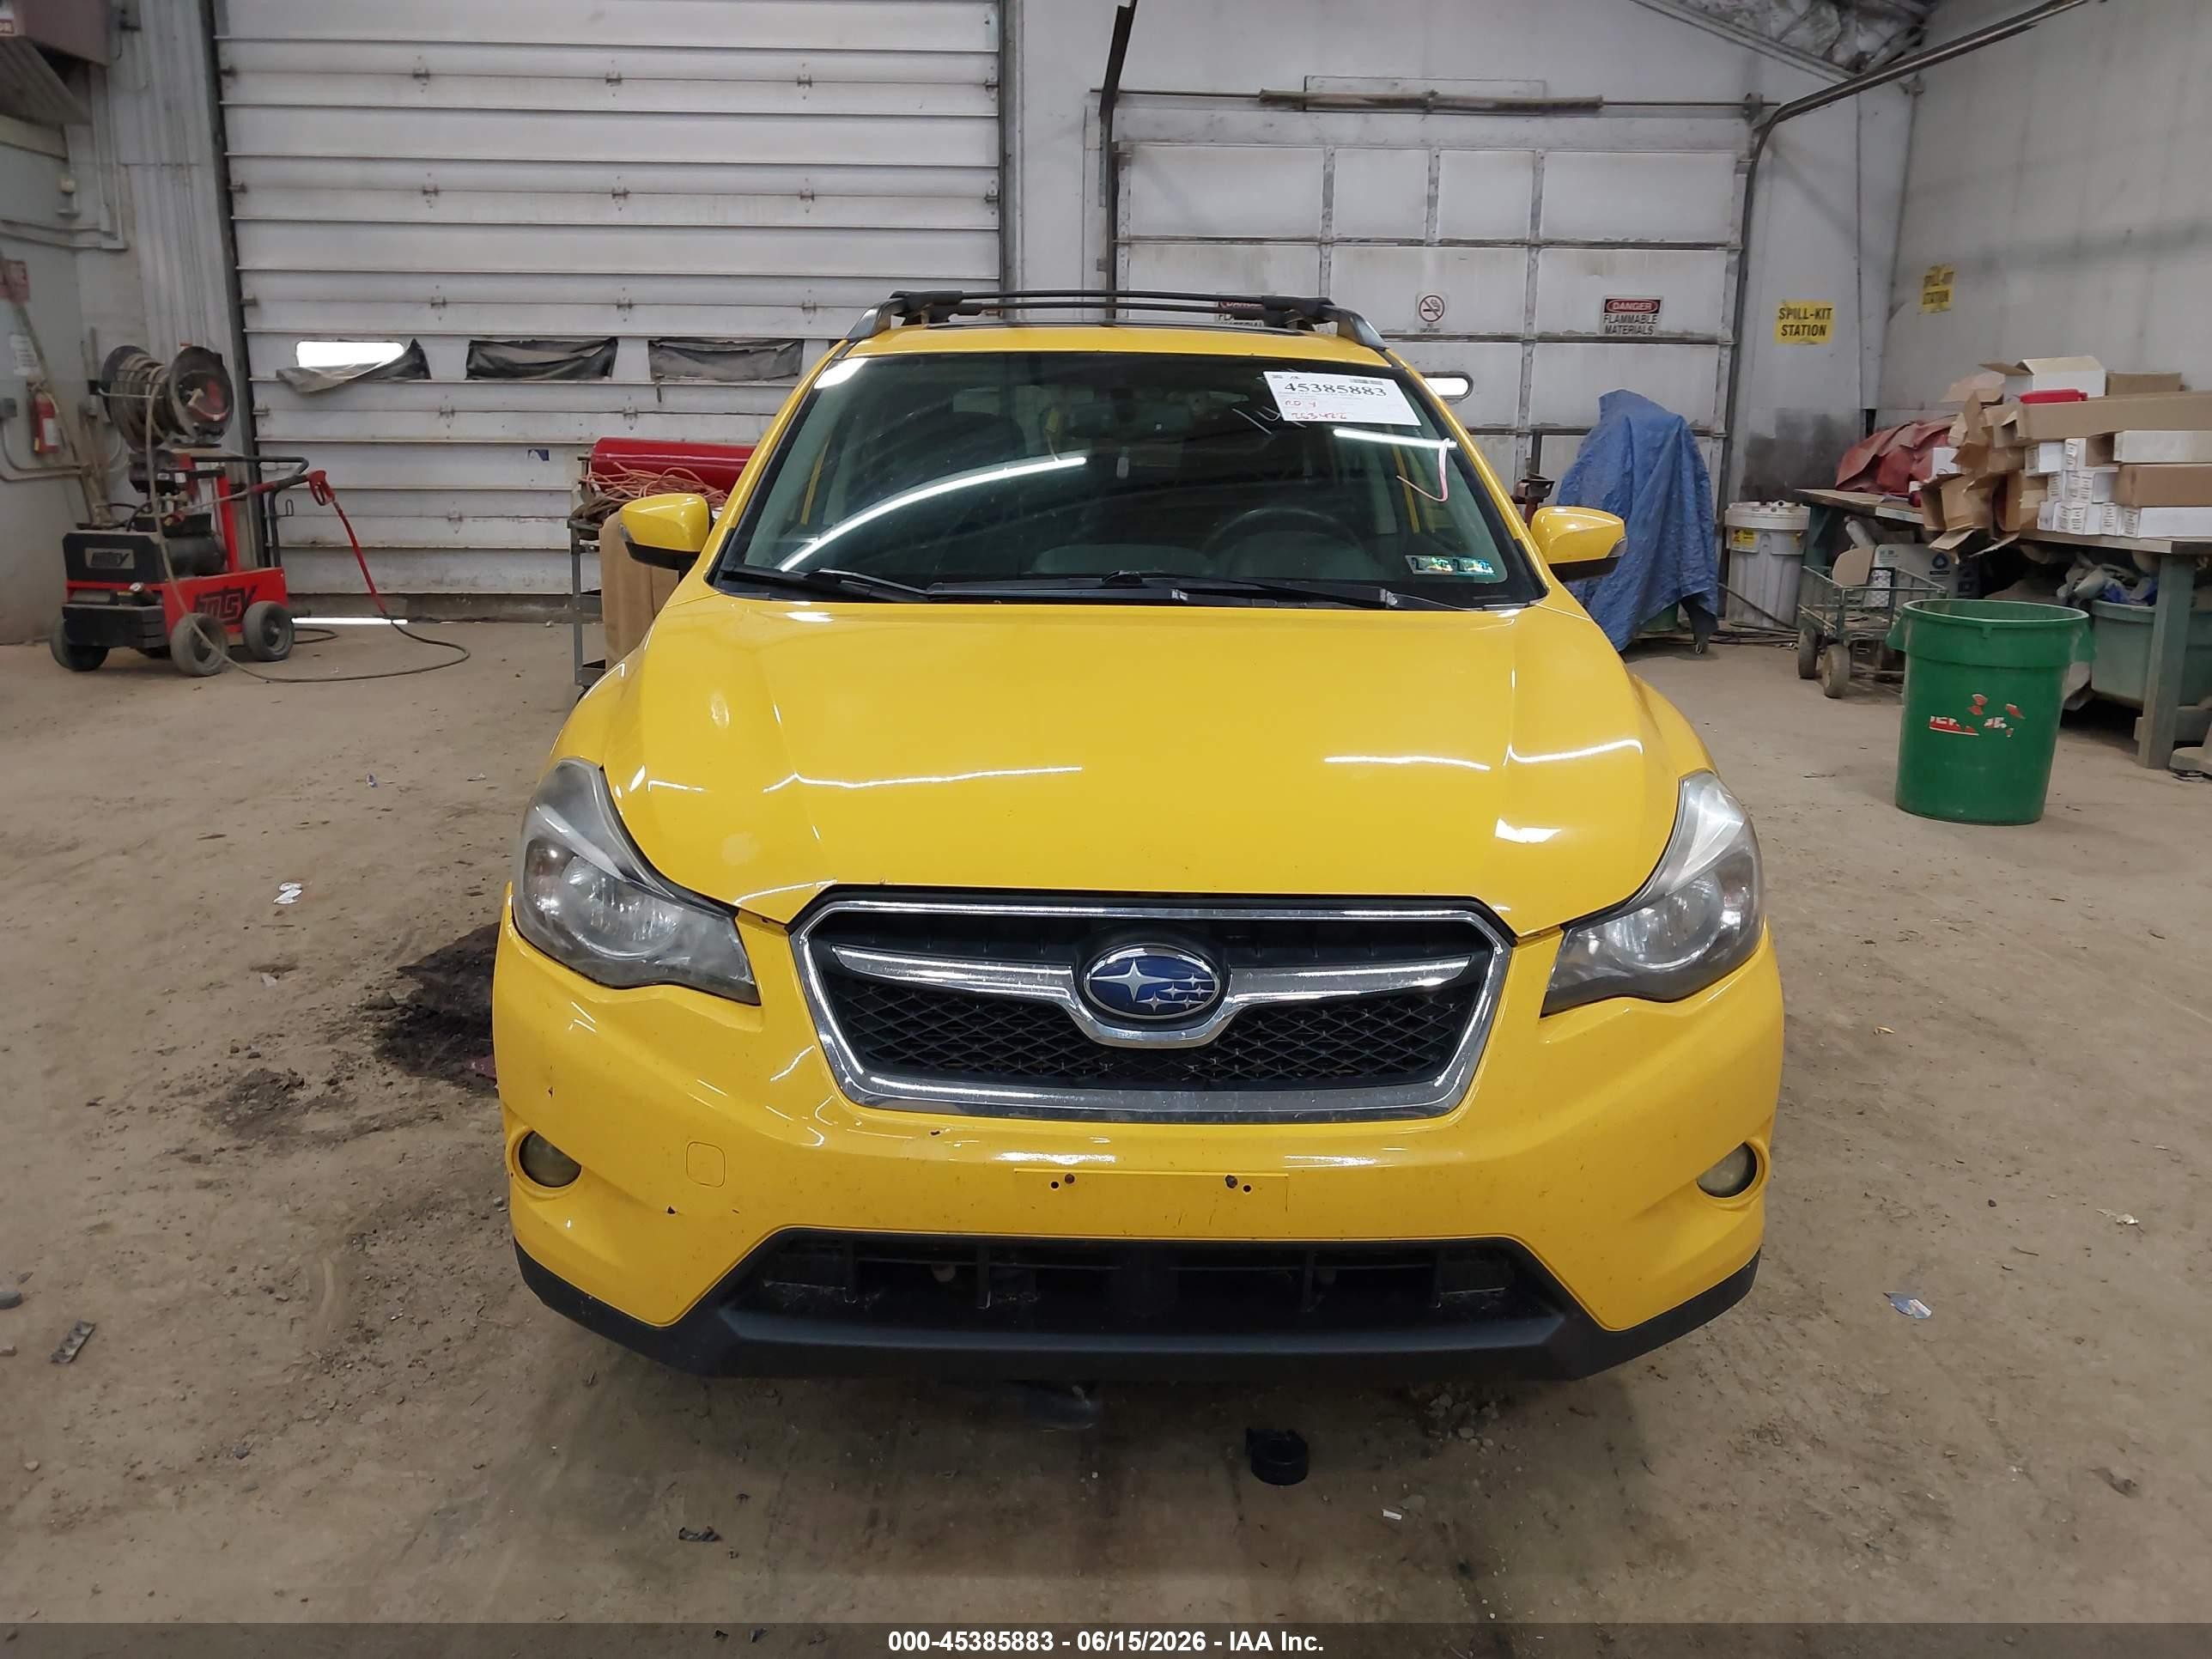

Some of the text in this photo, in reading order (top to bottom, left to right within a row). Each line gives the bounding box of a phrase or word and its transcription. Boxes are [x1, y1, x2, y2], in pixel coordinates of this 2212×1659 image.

[1612, 301, 1652, 310] DANGER
[1603, 313, 1657, 324] FLAMMABLE
[1778, 307, 1832, 319] SPILL-KIT
[1604, 325, 1654, 335] MATERIALS
[1781, 325, 1827, 337] STATION
[1284, 382, 1388, 397] 45385883
